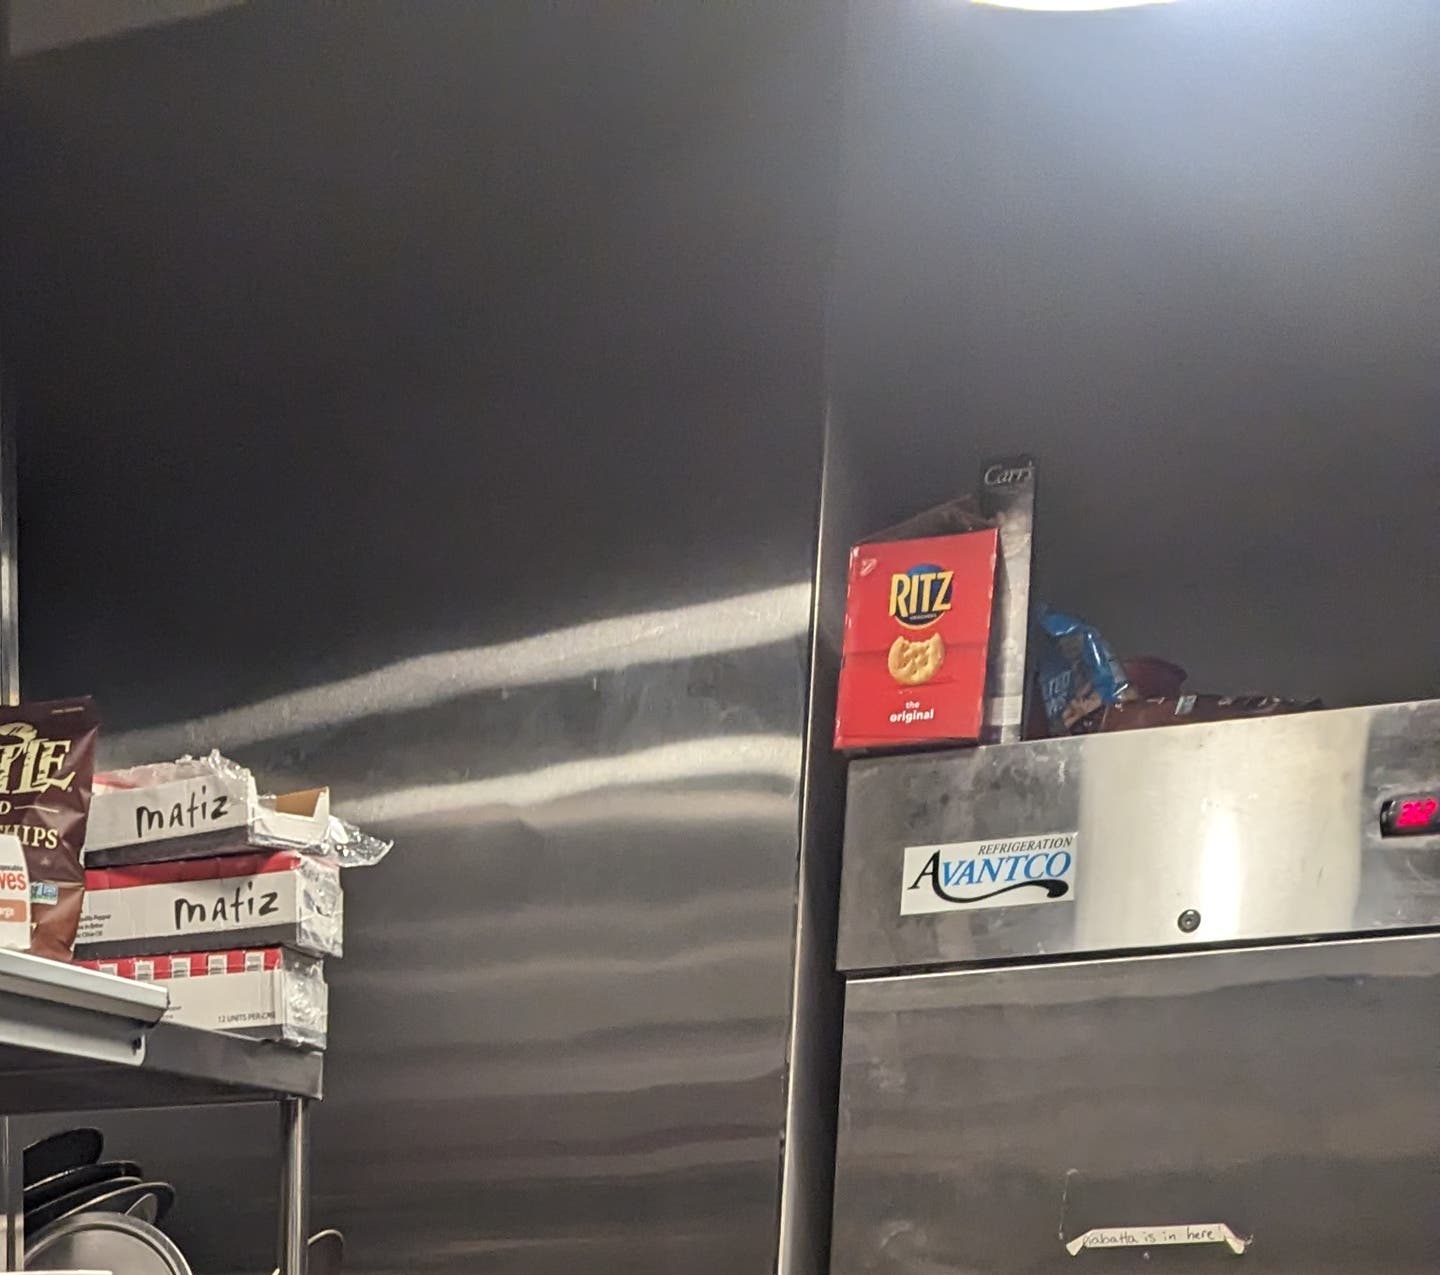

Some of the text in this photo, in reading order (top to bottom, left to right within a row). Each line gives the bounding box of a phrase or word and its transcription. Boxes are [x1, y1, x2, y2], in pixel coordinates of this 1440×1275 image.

[889, 569, 954, 617] RITZ
[904, 700, 921, 710] the
[888, 707, 935, 724] original
[136, 785, 229, 838] matiz
[978, 837, 1073, 856] REFRIGERATION
[906, 848, 1072, 899] AVANTCO
[173, 881, 279, 929] matiz
[227, 1013, 247, 1022] UNITS
[1143, 1230, 1156, 1243] is
[1162, 1230, 1178, 1242] in
